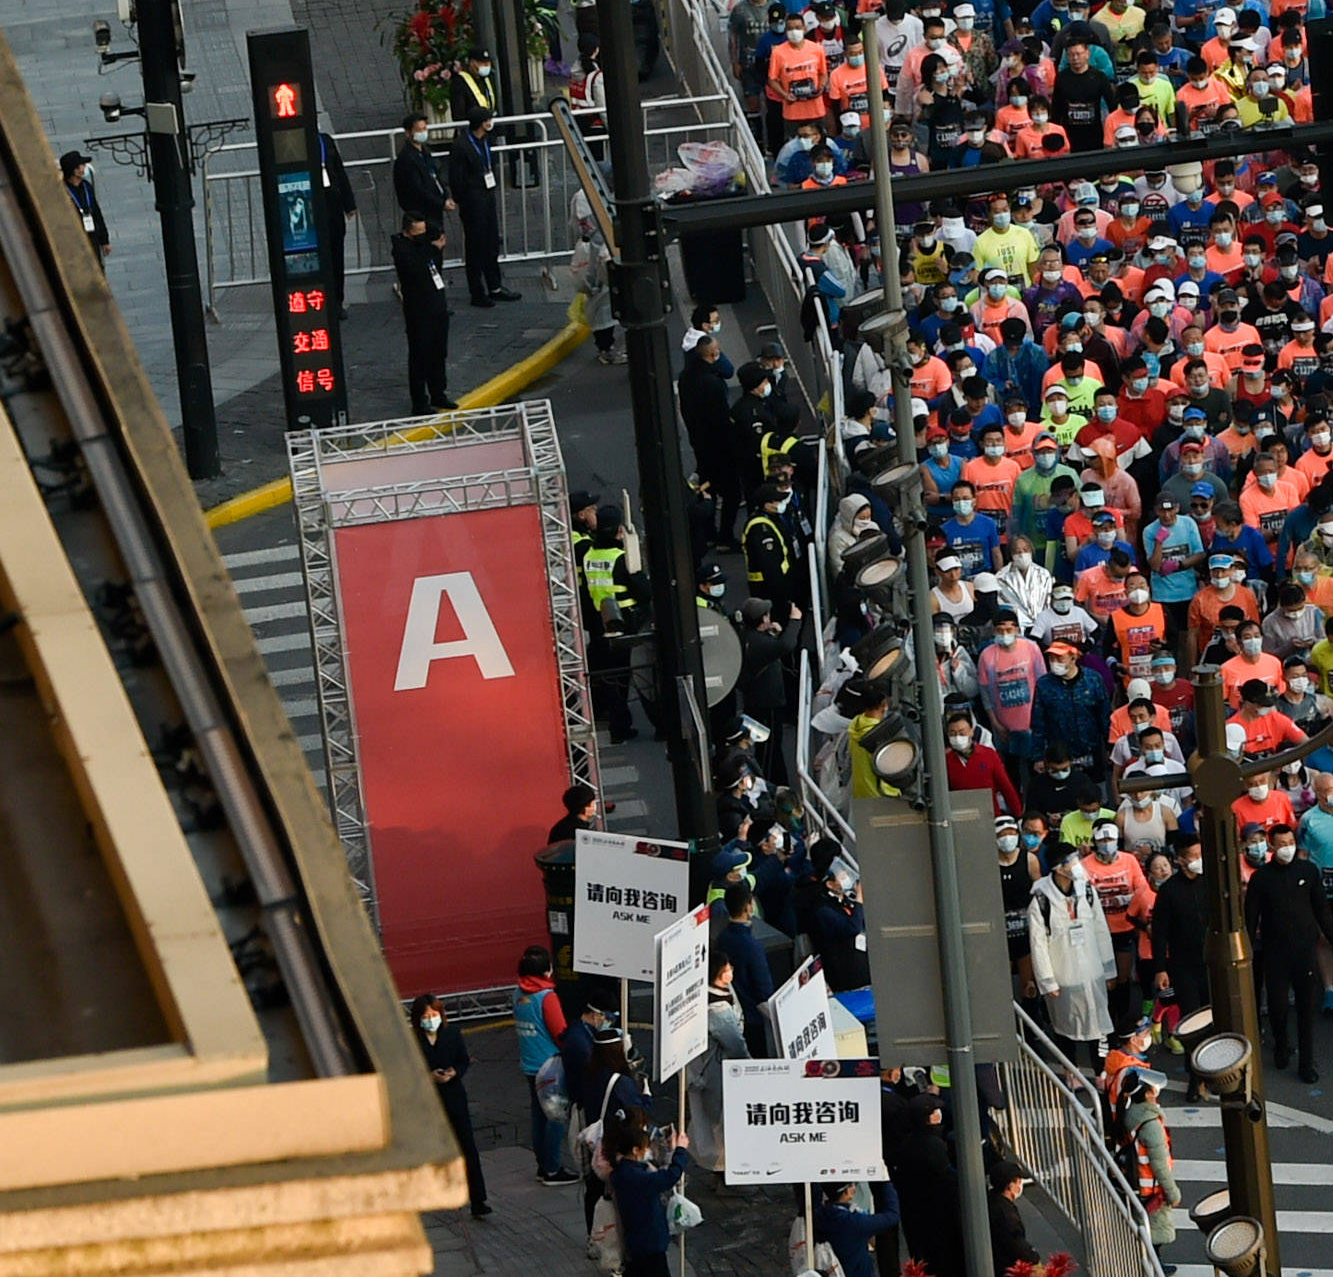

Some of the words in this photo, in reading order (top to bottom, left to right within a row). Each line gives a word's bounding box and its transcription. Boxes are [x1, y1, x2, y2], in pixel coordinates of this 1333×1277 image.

[293, 329, 329, 353] 交通
[297, 369, 334, 393] 信号
[394, 570, 516, 692] A
[587, 882, 677, 913] 请向我咨询
[612, 911, 634, 922] ASK
[636, 913, 651, 924] ME
[788, 1012, 827, 1059] 请向我咨询
[746, 1100, 860, 1126] 请向我咨询
[780, 1132, 806, 1144] ASK
[809, 1132, 827, 1143] ME
